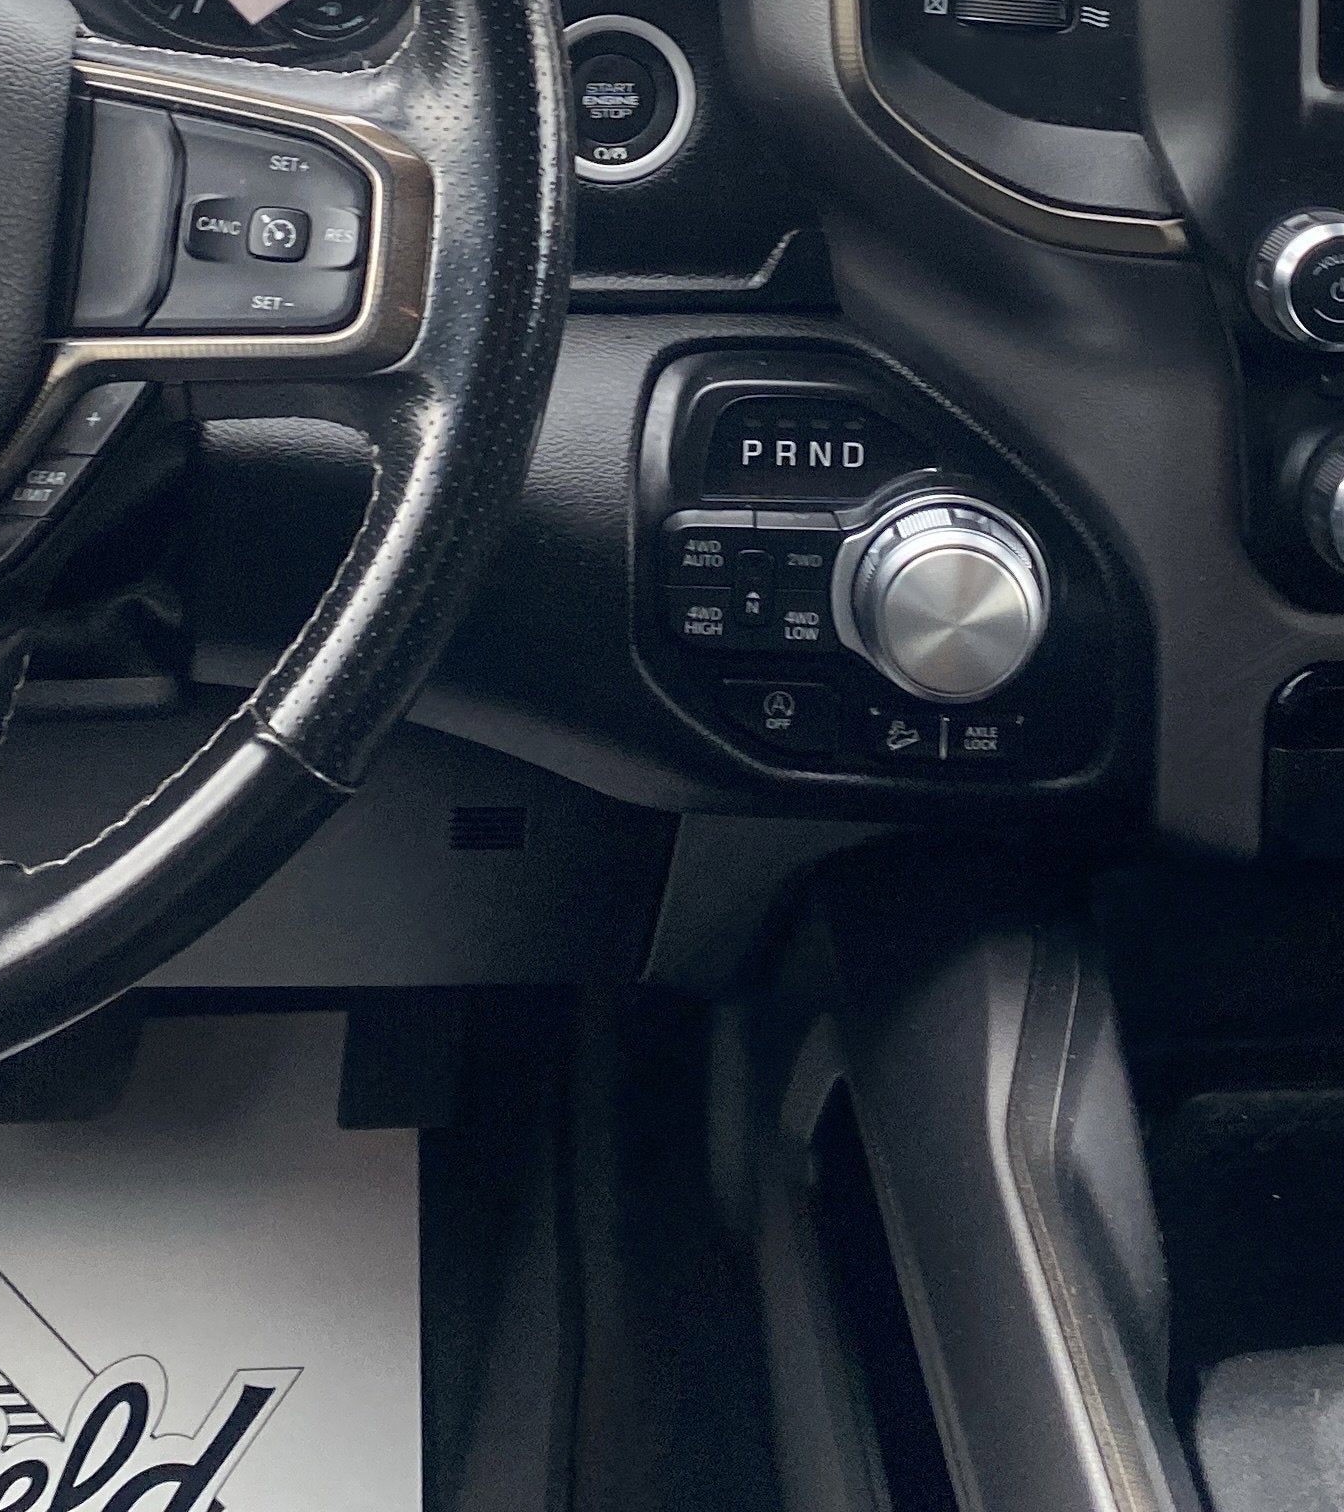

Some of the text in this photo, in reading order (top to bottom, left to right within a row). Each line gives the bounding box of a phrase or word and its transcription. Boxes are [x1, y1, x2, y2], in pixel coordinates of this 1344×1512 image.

[585, 82, 636, 93] START
[581, 95, 640, 106] ENGINE
[590, 108, 633, 119] STOP
[195, 215, 242, 236] CANC
[323, 226, 355, 244] RES
[684, 540, 722, 554] 4WD
[682, 554, 724, 568] AUTO
[786, 553, 824, 568] 2WD
[686, 606, 723, 621] 4WD
[745, 601, 760, 615] N
[784, 610, 820, 625] 4WD
[683, 622, 723, 637] HIGH
[784, 626, 820, 640] LOW
[765, 718, 792, 730] OFF
[964, 726, 999, 738] AXLE
[964, 738, 998, 751] LOCK
